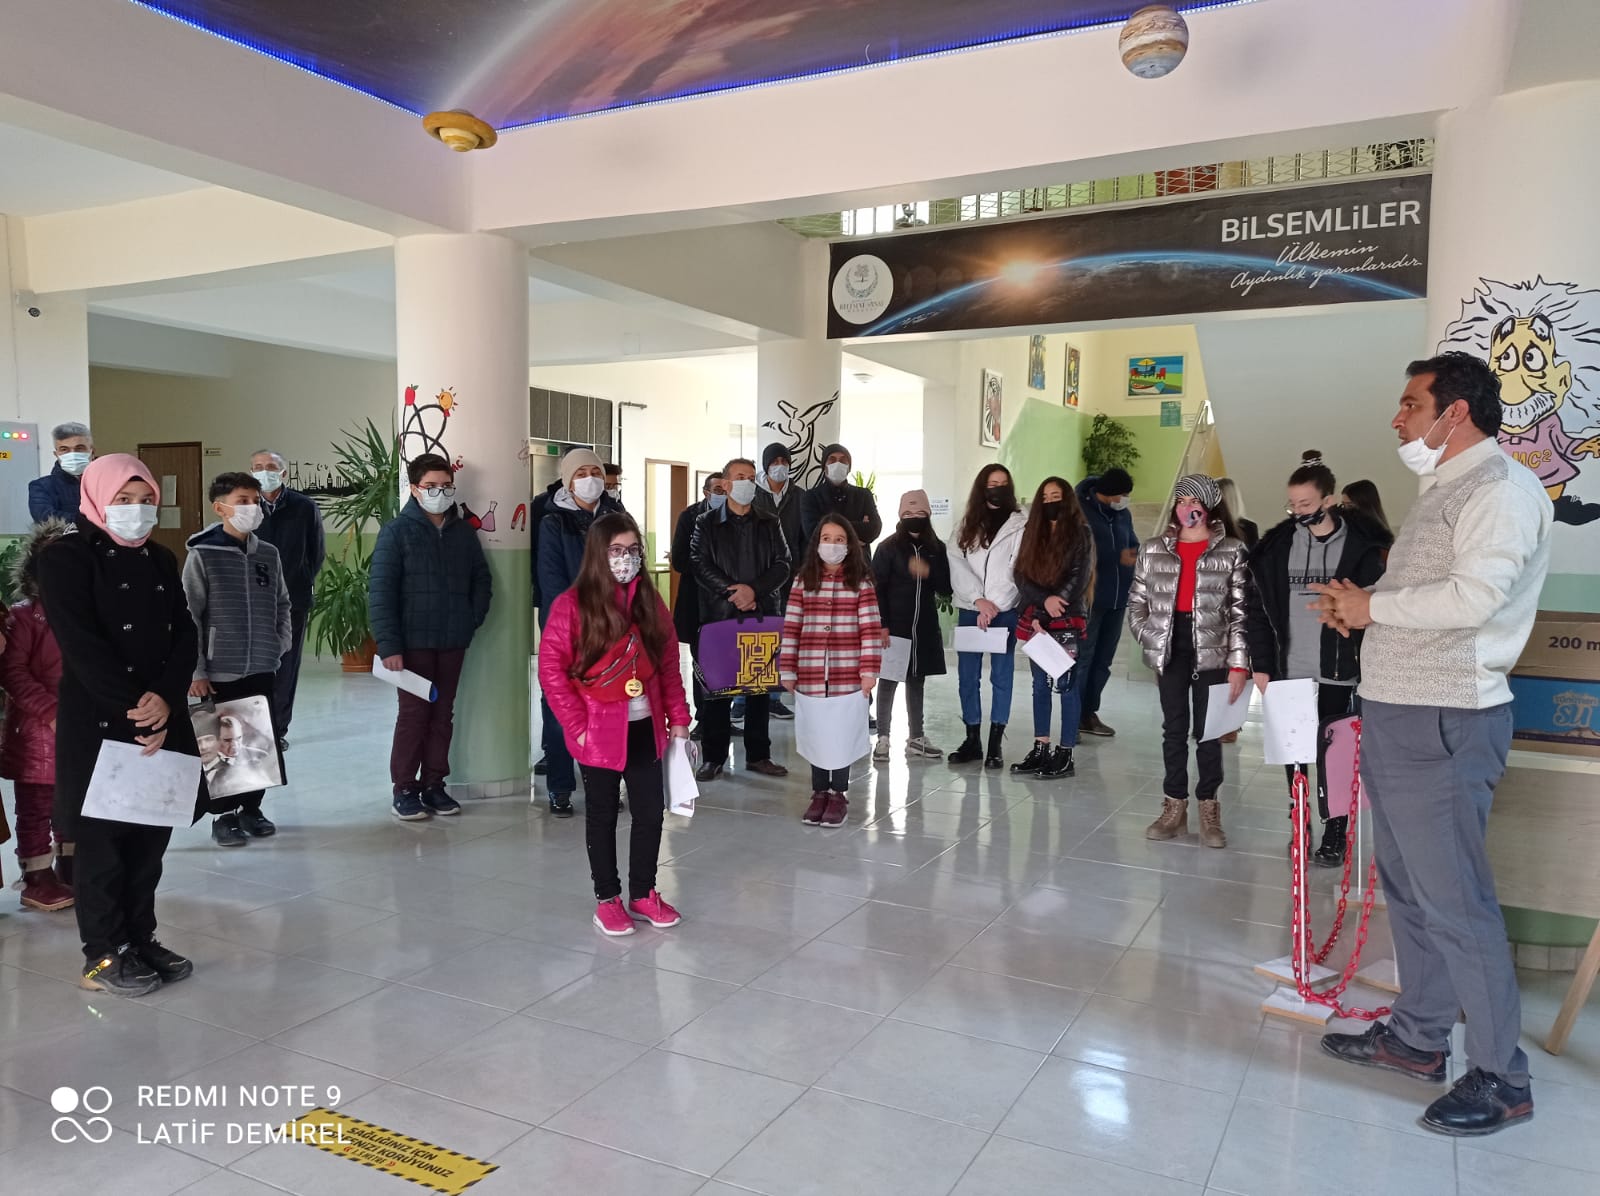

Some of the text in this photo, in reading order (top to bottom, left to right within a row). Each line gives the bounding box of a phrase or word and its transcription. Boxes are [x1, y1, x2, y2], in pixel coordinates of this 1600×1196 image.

[1275, 240, 1379, 266] Ülkemin
[1548, 636, 1582, 650] 200
[736, 632, 779, 686] H
[347, 1127, 413, 1152] SAĞLIĞINIZ
[378, 1147, 454, 1177] KORUYUNUZ
